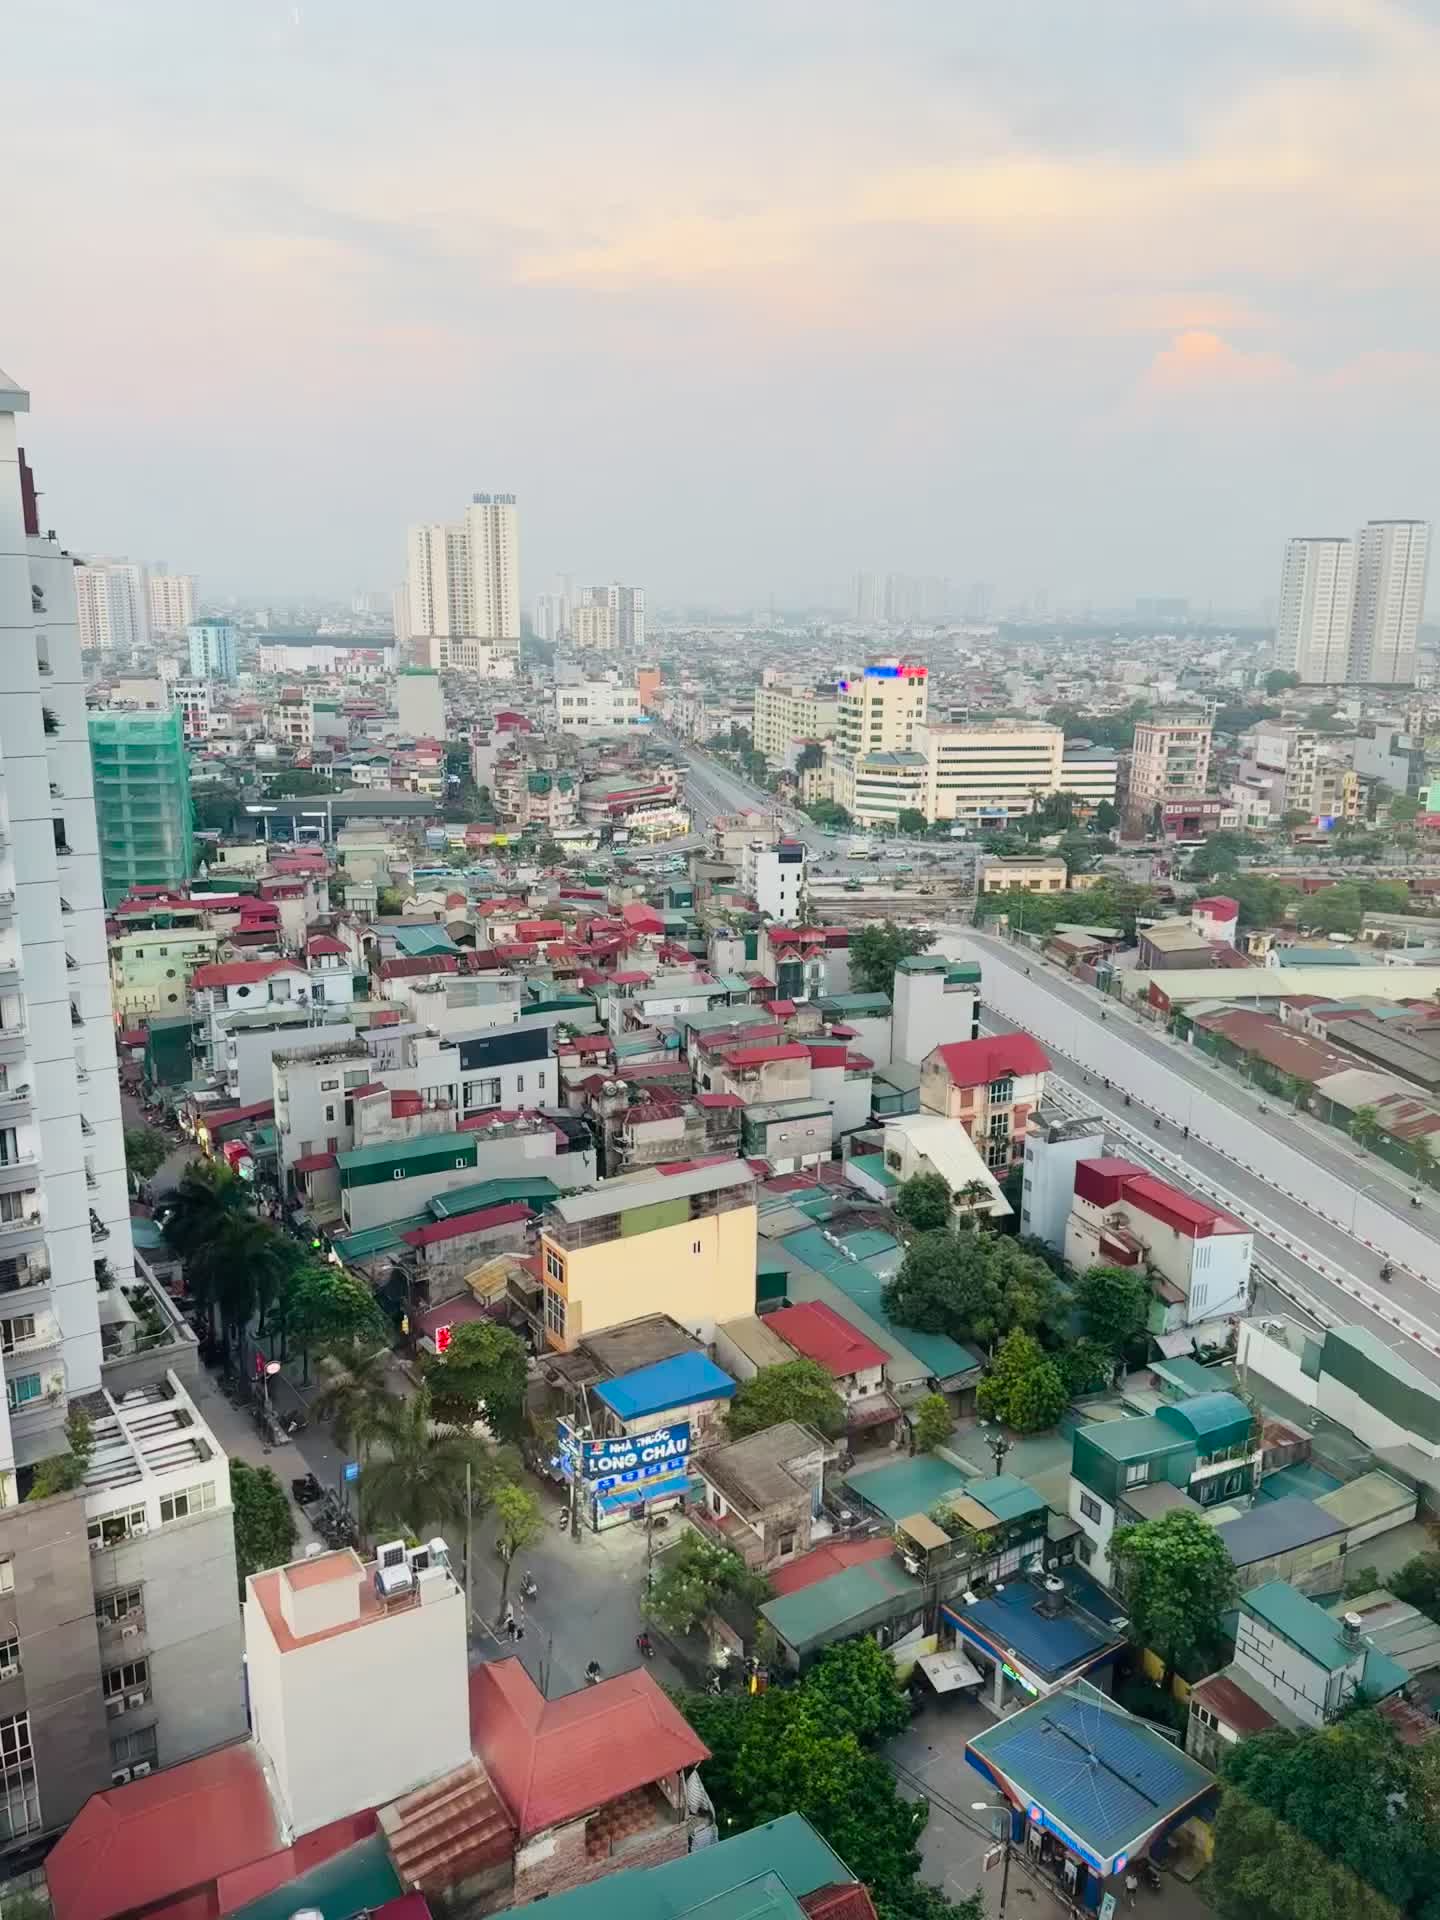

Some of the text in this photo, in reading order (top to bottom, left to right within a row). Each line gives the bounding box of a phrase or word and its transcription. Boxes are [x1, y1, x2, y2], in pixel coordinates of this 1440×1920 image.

[589, 1438, 687, 1472] LONG CHÂU
[609, 1439, 633, 1453] NHÀ
[636, 1429, 670, 1447] THUỐC
